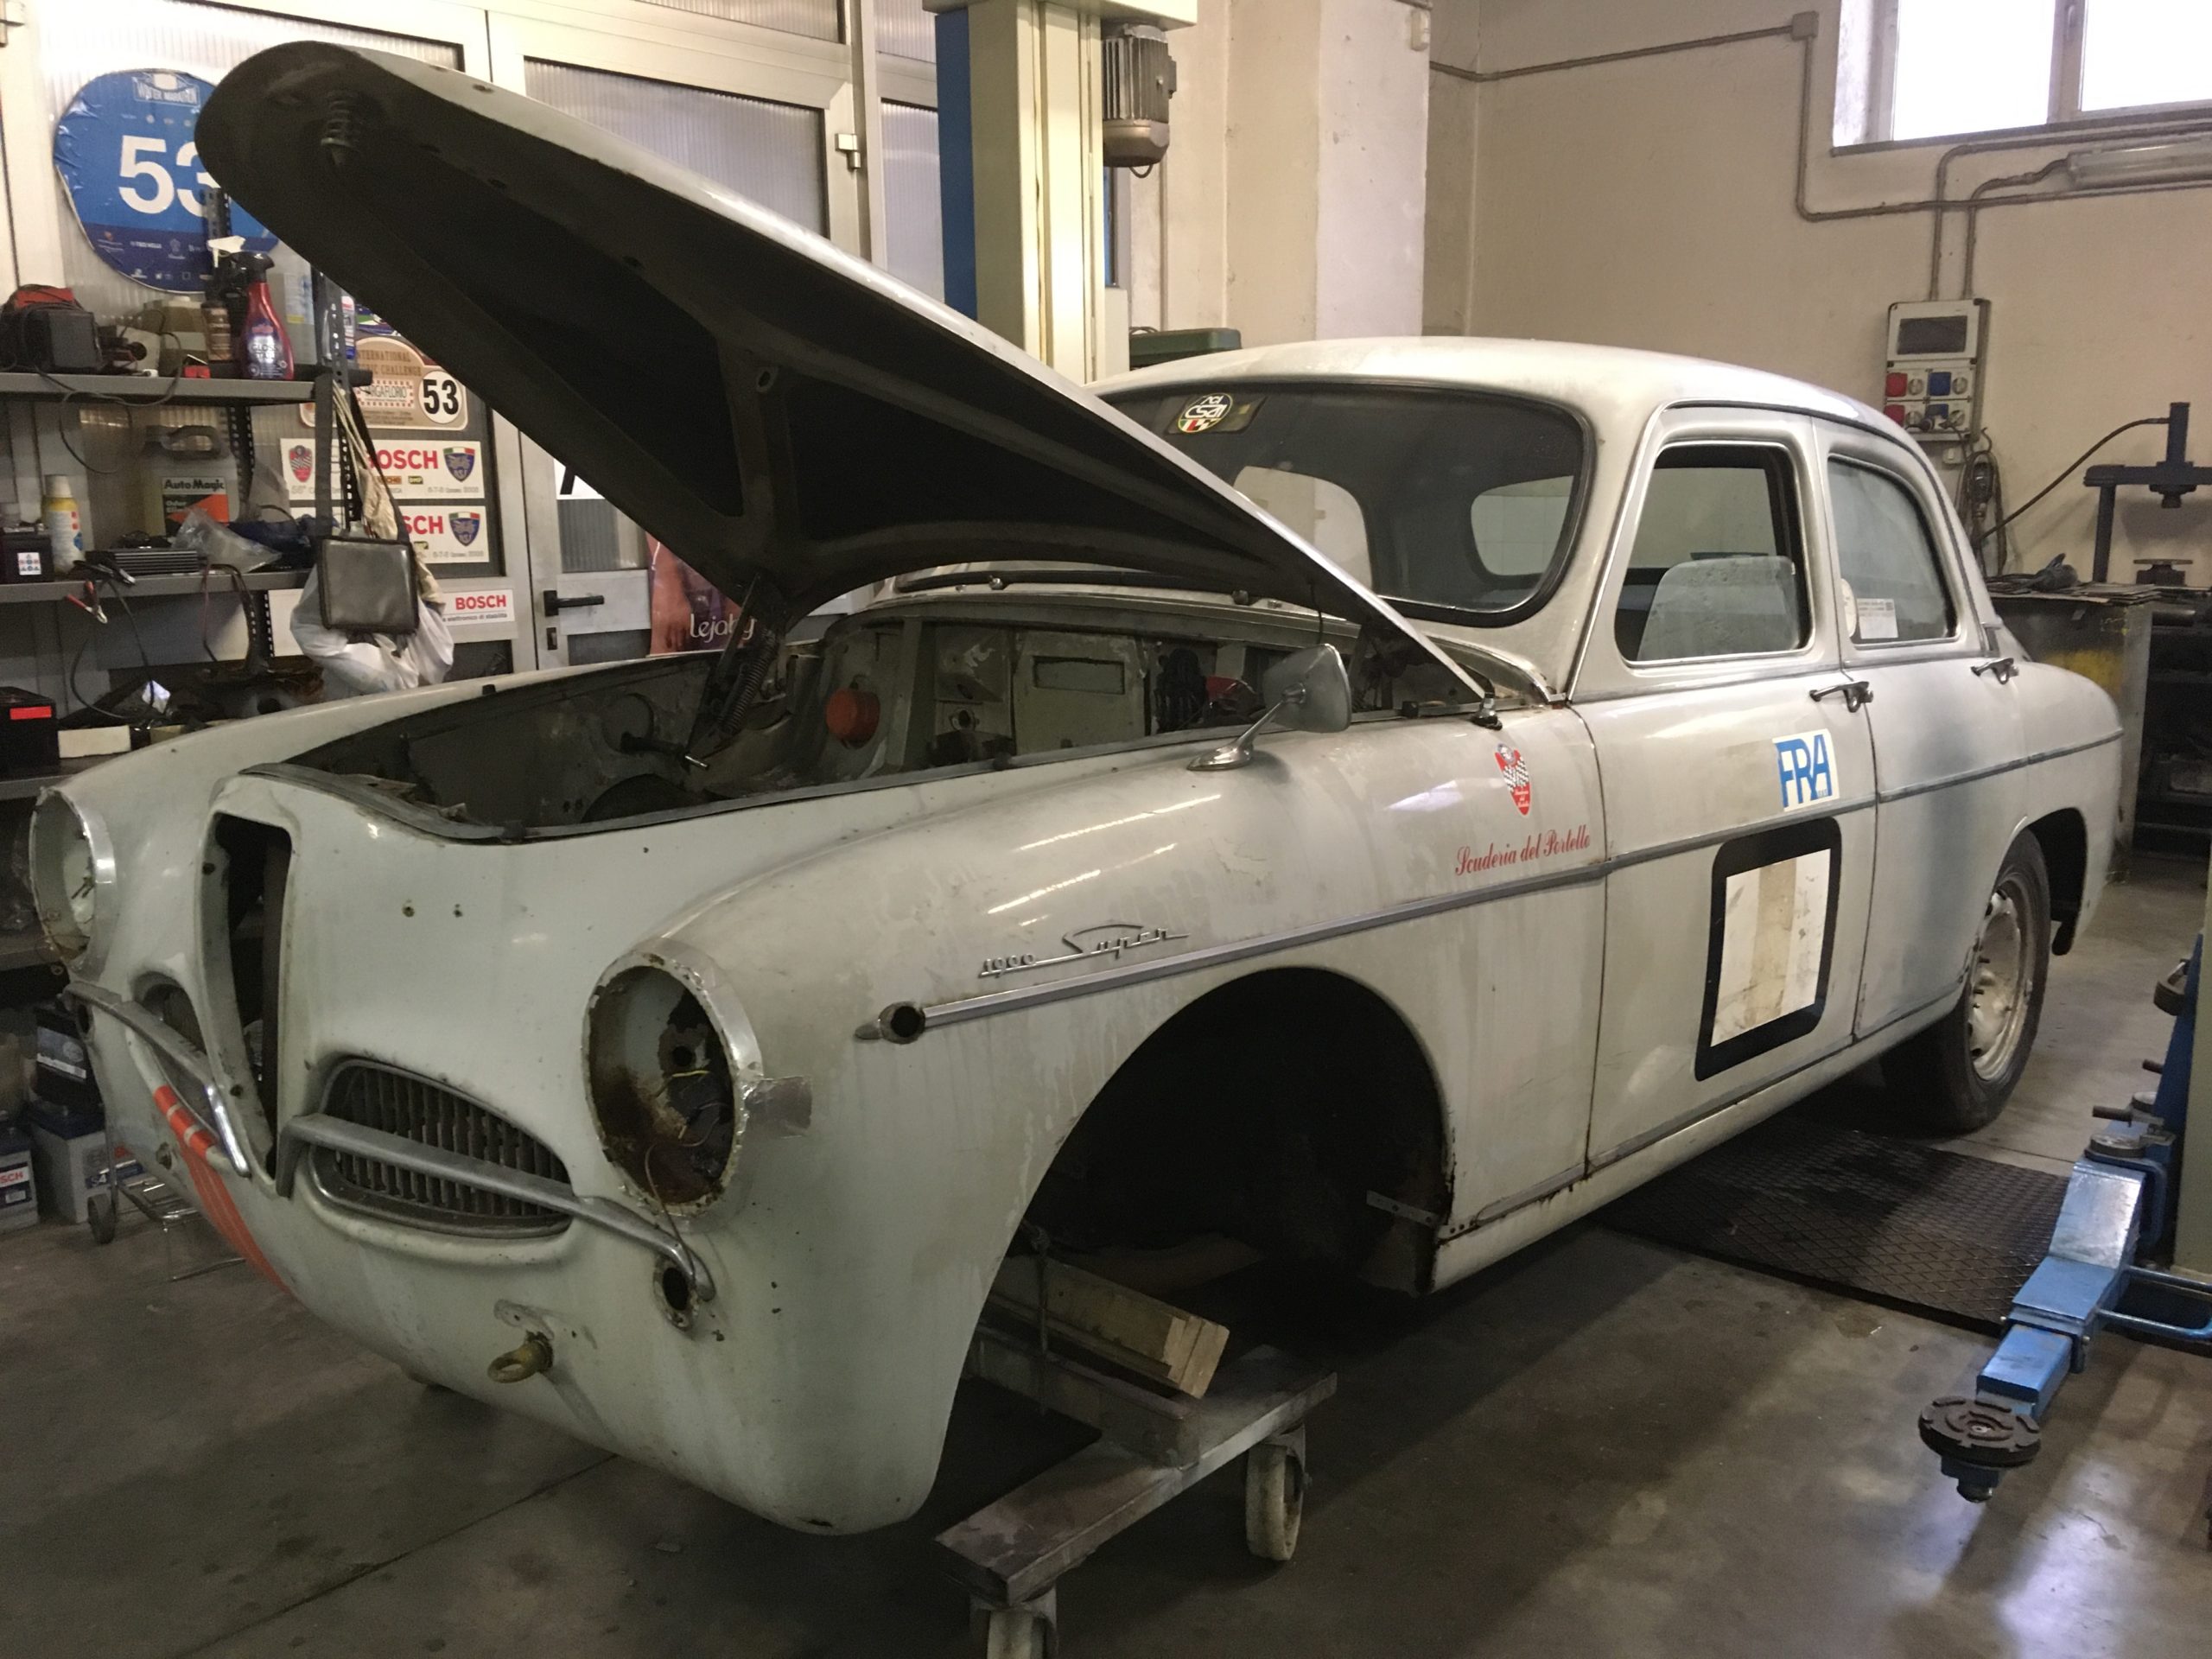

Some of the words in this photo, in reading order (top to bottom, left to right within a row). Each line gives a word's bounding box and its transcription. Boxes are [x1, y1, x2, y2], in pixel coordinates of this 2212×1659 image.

[423, 378, 460, 416] 53
[369, 449, 439, 470] OSCH
[164, 479, 190, 490] Auto
[193, 479, 225, 493] Magic
[403, 515, 444, 535] SCH
[455, 594, 506, 611] BOSCH
[1774, 734, 1833, 808] FRA
[1455, 842, 1518, 876] Scuderia
[1520, 832, 1542, 862] del
[1543, 823, 1590, 857] Portello
[979, 953, 1036, 978] 1900
[0, 1170, 23, 1184] SCH
